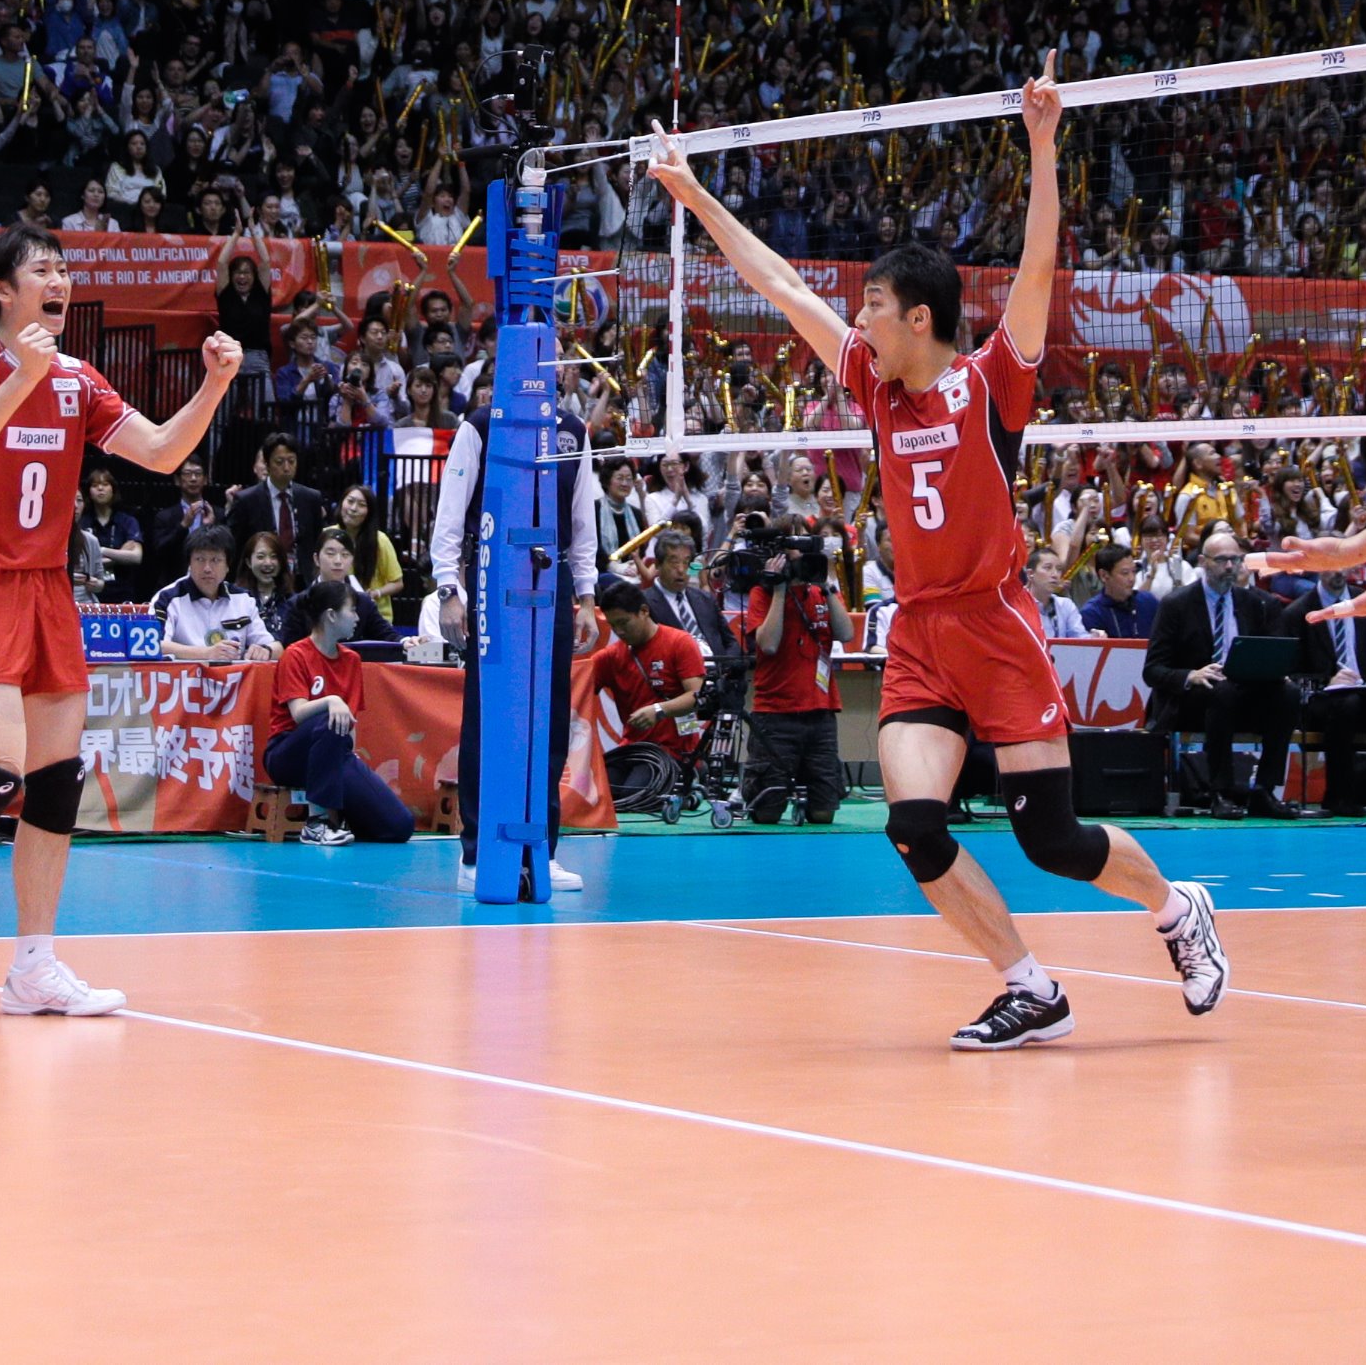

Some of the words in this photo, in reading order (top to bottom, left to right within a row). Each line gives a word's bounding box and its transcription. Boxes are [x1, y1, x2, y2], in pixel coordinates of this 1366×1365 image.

[1321, 51, 1346, 66] FIVB
[99, 248, 127, 261] FINAL
[132, 247, 209, 262] QUALIFICATION
[559, 254, 589, 266] FIVB
[70, 270, 91, 285] FOR
[94, 270, 113, 284] THE
[116, 270, 134, 285] RIO
[137, 271, 150, 284] DE
[154, 269, 199, 285] JANEIRO
[522, 380, 546, 390] FIVB
[16, 430, 60, 446] Japanet
[899, 430, 948, 451] Japanet
[19, 461, 48, 530] 8
[910, 459, 946, 531] 5
[479, 543, 492, 657] Senoh
[129, 627, 160, 657] 23
[97, 650, 126, 658] Senoh
